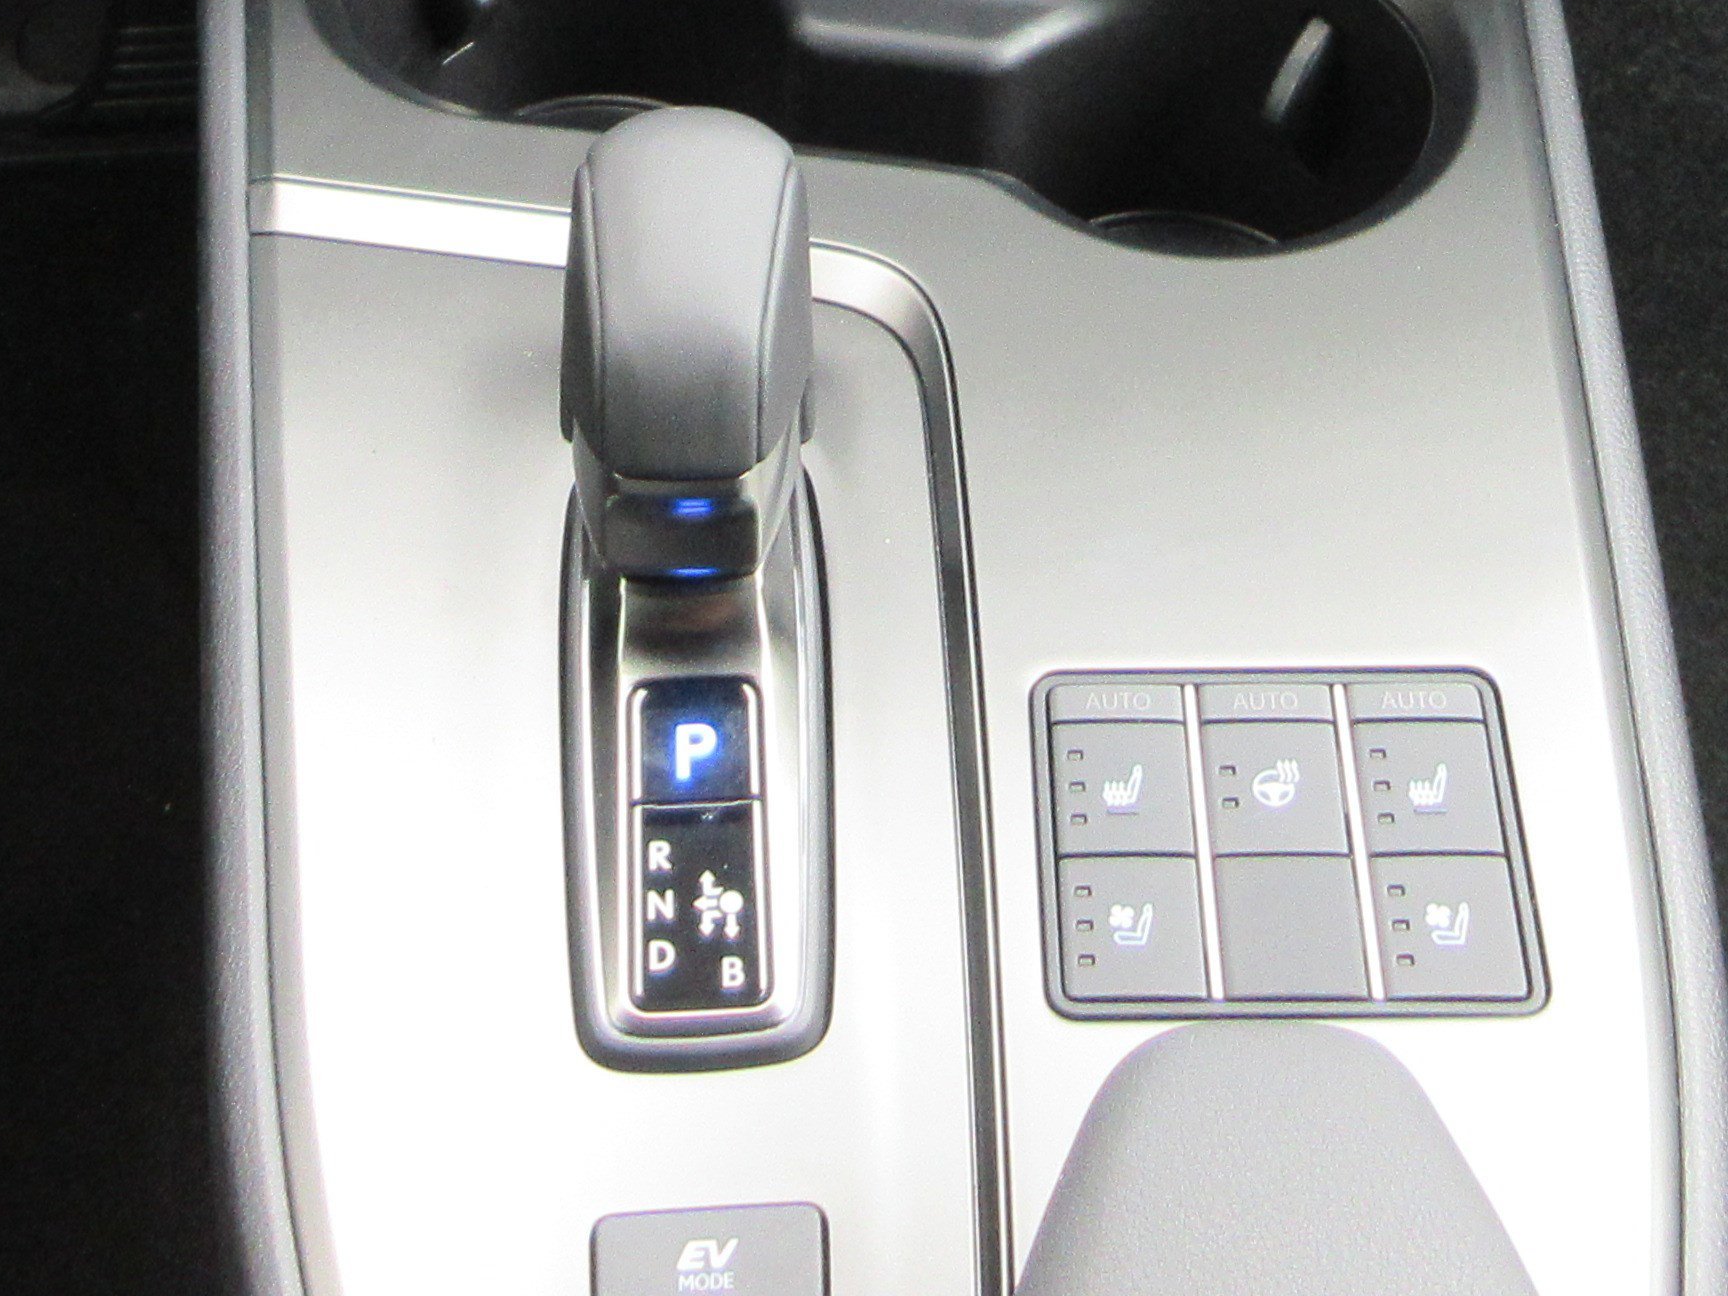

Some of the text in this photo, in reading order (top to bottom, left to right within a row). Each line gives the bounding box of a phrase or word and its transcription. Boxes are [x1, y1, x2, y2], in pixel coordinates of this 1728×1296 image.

[1085, 690, 1152, 712] AUTO
[1233, 690, 1299, 712] AUTO
[1381, 690, 1448, 711] AUTO
[674, 721, 718, 781] P
[648, 840, 672, 871] R
[648, 889, 674, 921] N
[648, 940, 676, 974] D
[721, 956, 746, 990] B
[676, 1237, 739, 1270] EV
[678, 1271, 735, 1292] MODE
